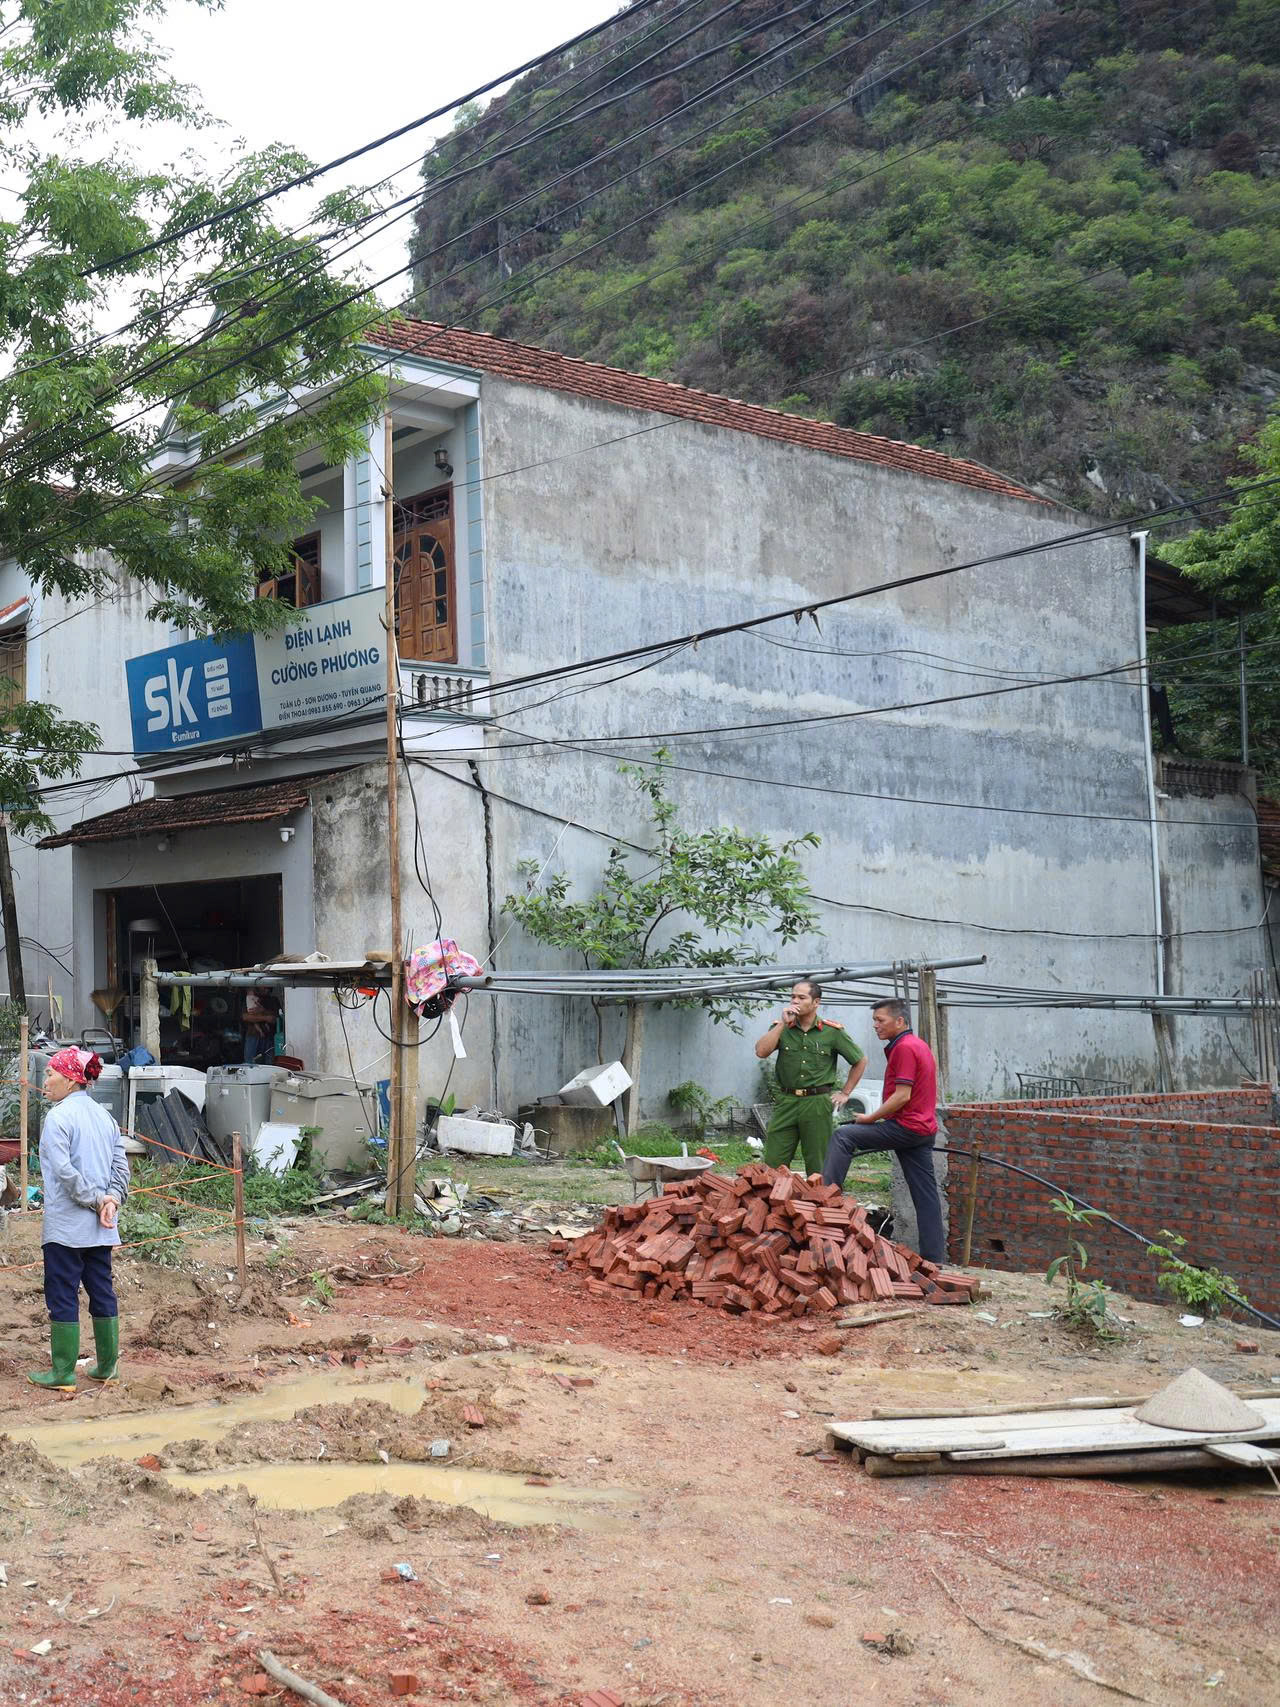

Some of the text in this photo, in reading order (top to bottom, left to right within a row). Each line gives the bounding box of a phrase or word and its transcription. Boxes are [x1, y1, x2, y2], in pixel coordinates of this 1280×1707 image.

[285, 619, 351, 652] ĐIỆN LẠNH
[272, 647, 380, 685] CƯỜNG PHƯƠNG
[360, 683, 381, 696] QUANG
